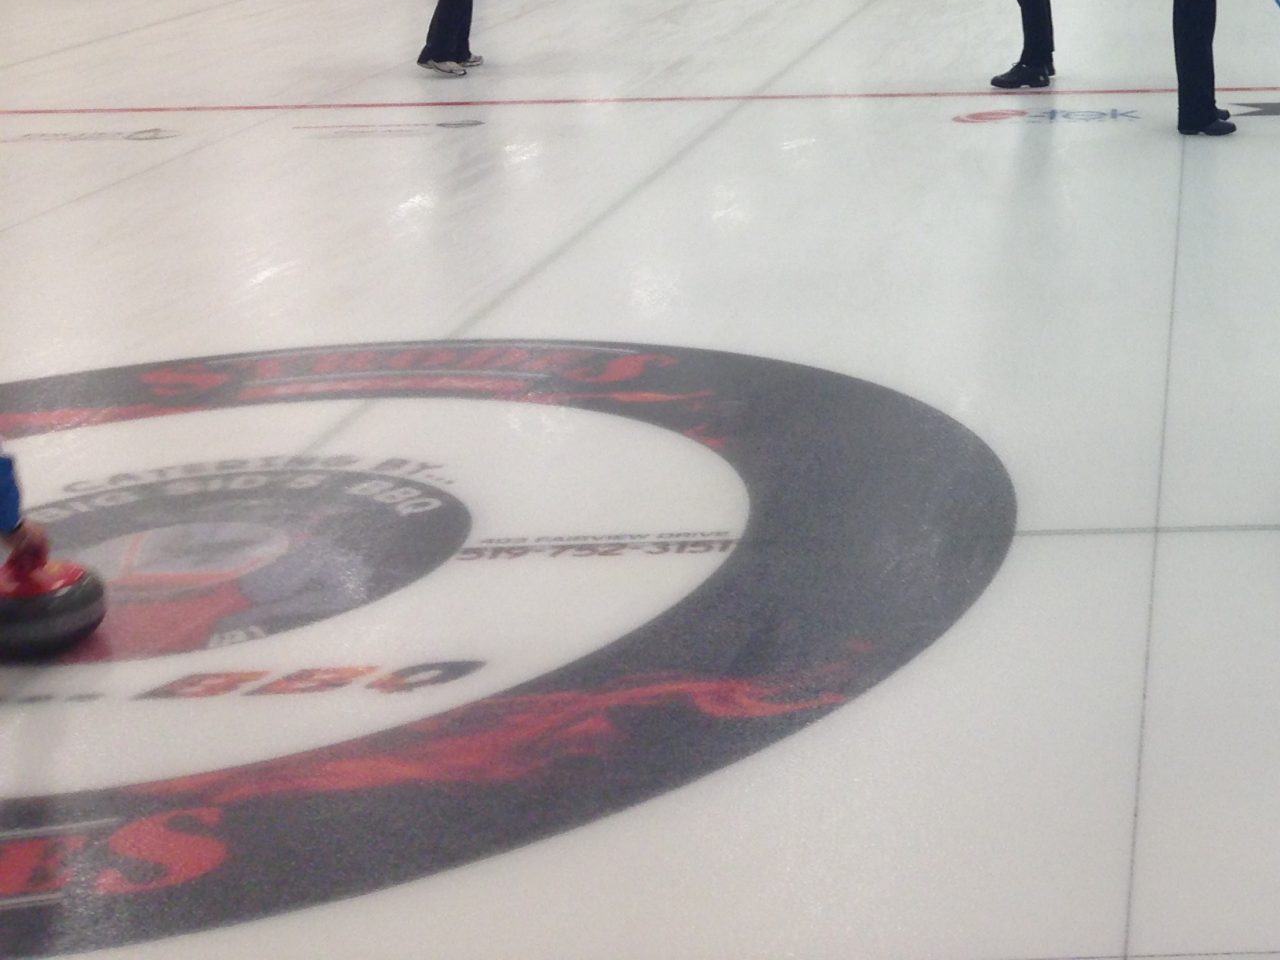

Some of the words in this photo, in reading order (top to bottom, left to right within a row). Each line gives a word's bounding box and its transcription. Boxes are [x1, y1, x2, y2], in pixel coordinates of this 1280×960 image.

[63, 453, 361, 493] CATERING
[344, 478, 442, 516] BBQ
[456, 540, 735, 561] 519-752-3151
[535, 534, 651, 543] FAIRVIEW
[657, 531, 730, 539] DRIVE
